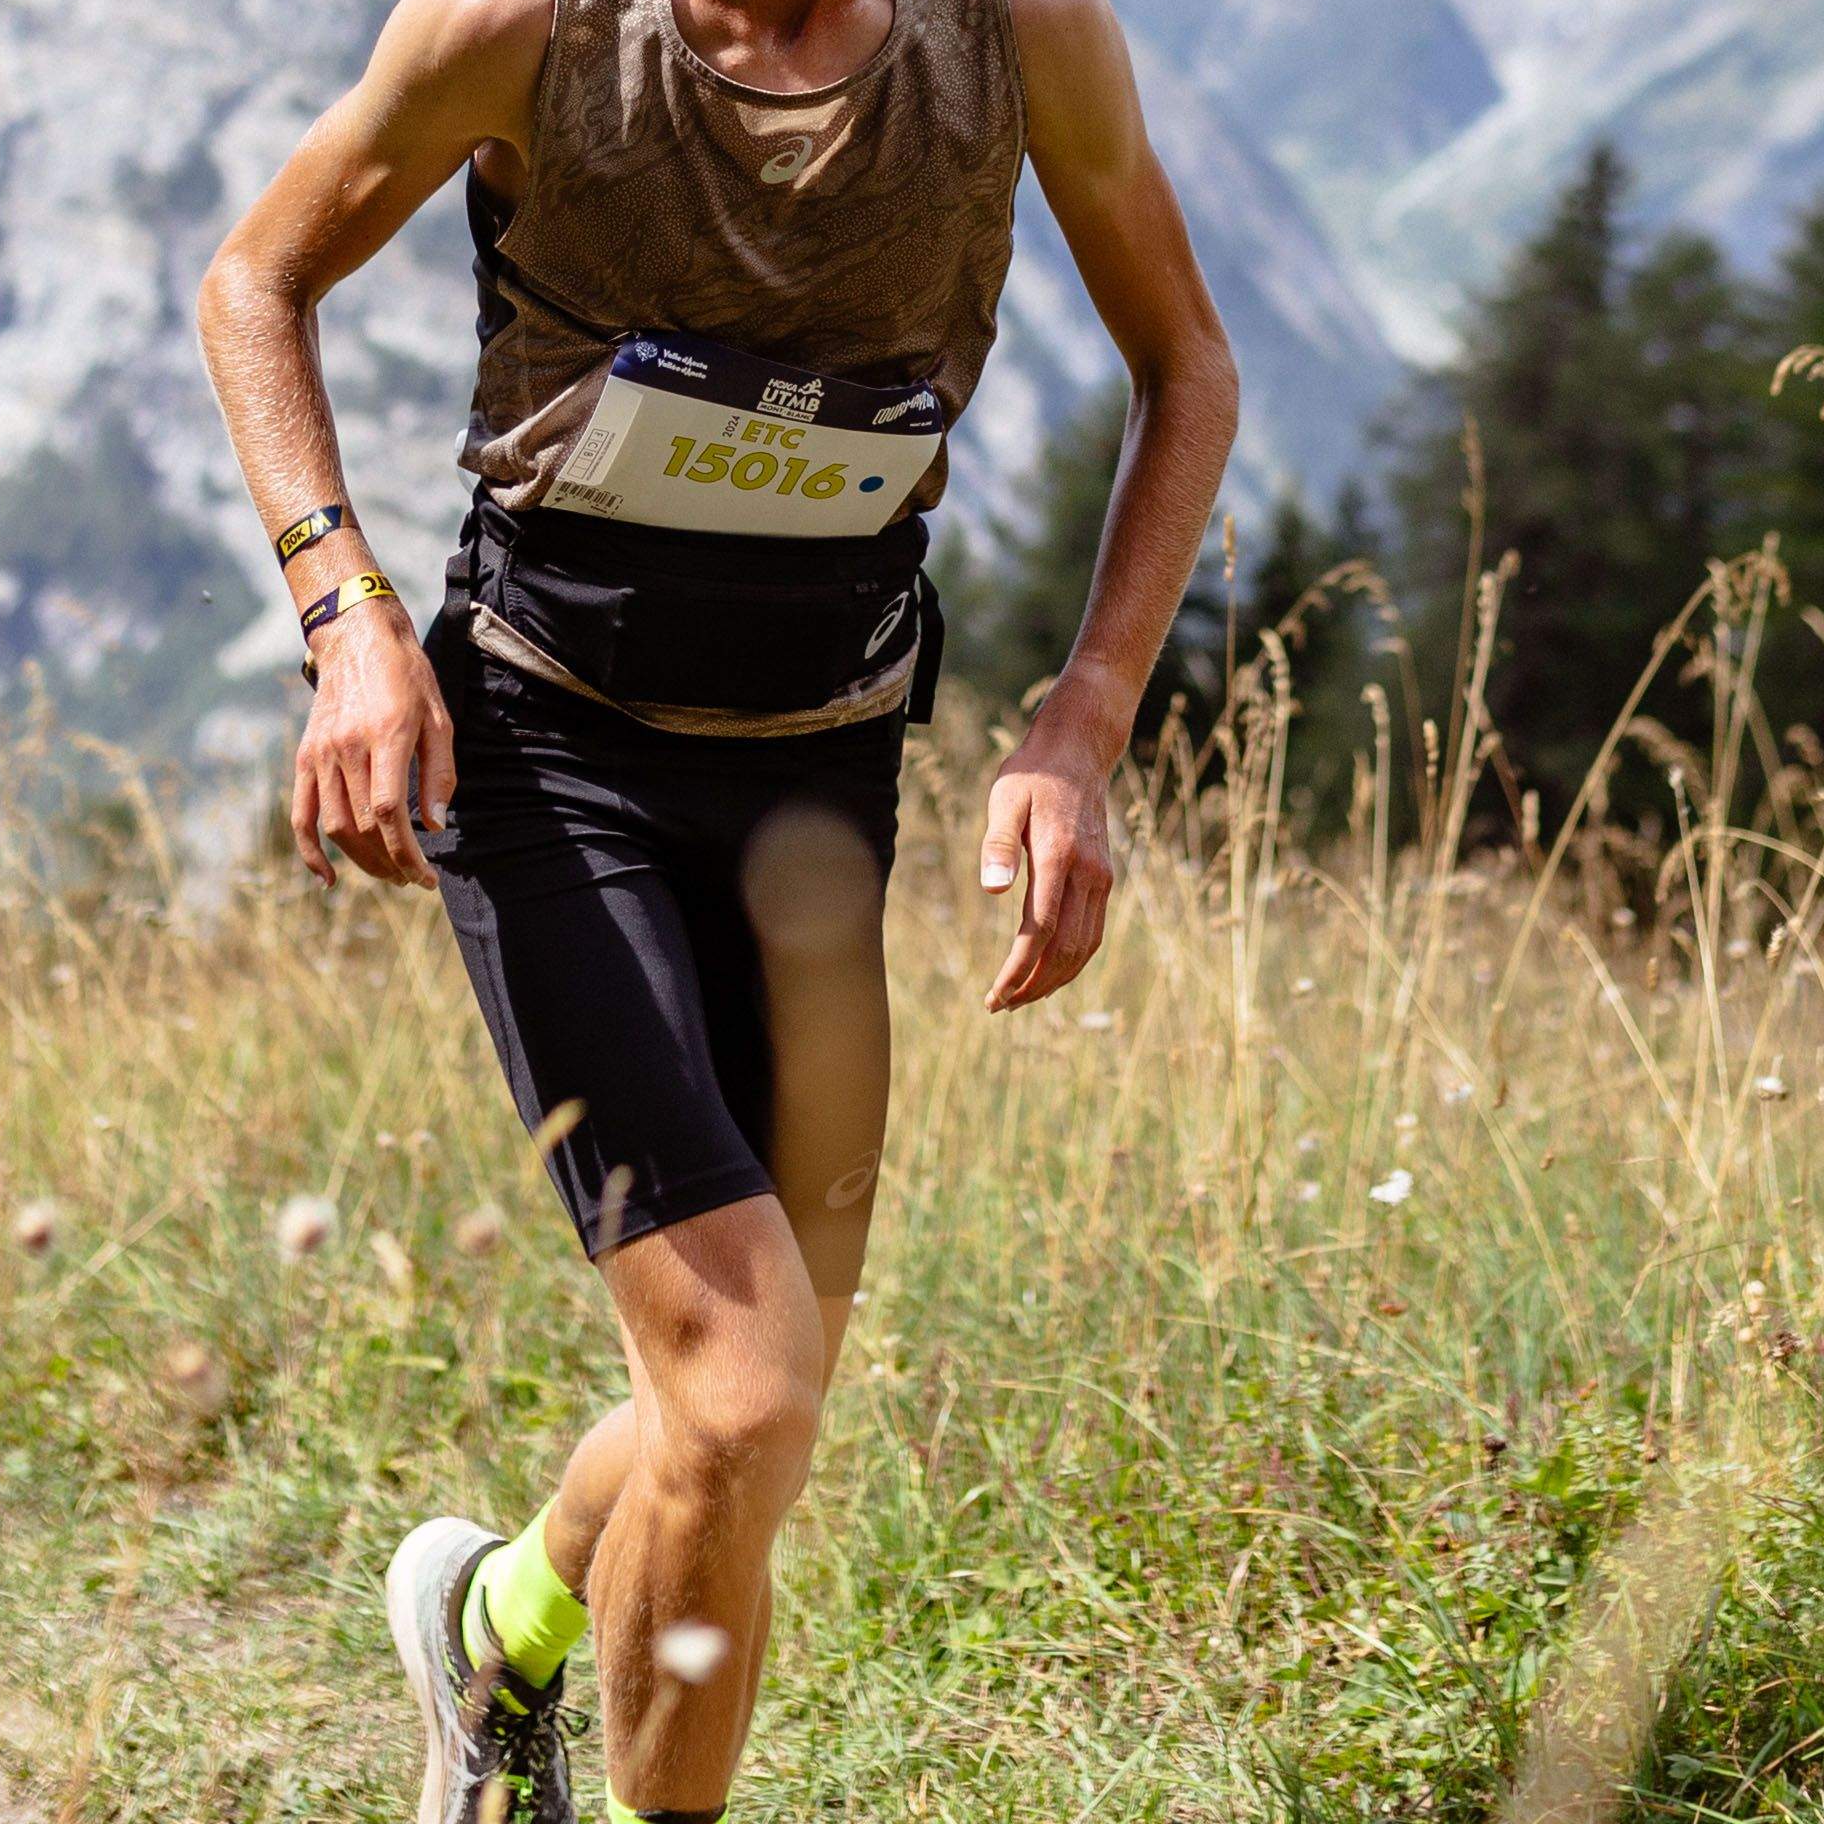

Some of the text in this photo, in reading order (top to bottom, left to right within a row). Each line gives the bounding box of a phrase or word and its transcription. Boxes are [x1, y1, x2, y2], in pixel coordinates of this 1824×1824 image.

[767, 378, 798, 392] HOKA
[761, 386, 821, 412] UTMB
[721, 415, 741, 438] 2024
[740, 419, 807, 450] ETC
[663, 435, 850, 500] 15016
[283, 528, 306, 553] 20K
